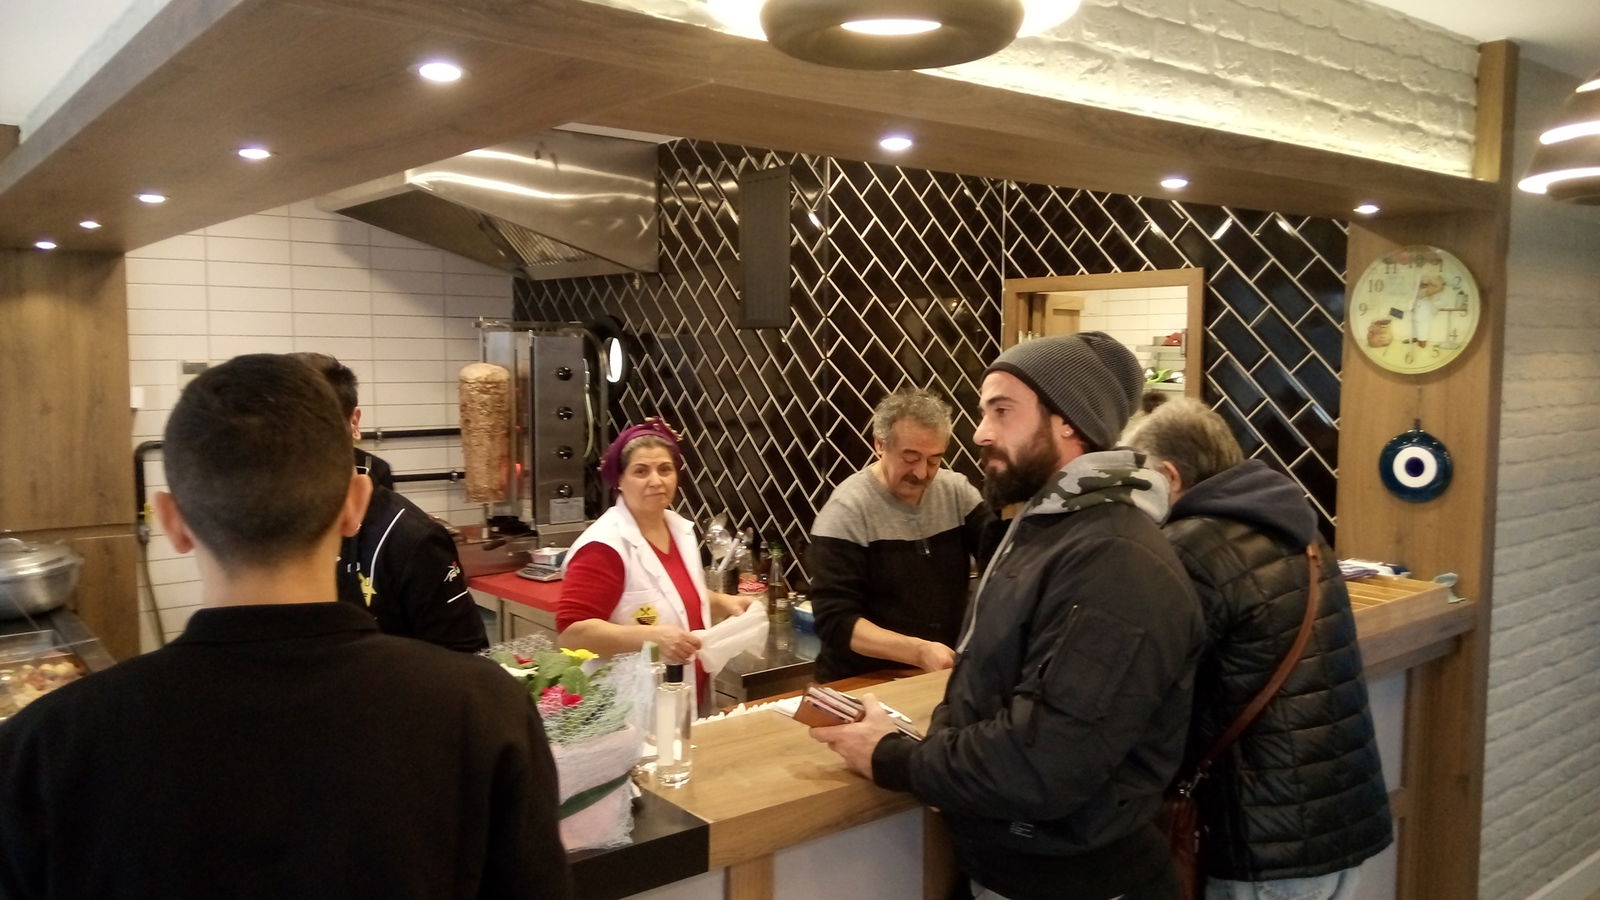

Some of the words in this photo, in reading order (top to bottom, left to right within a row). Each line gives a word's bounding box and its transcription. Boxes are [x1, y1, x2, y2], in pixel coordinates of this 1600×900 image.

[1368, 279, 1384, 293] 10
[1452, 275, 1462, 289] 2
[1358, 303, 1368, 316] 9
[1449, 328, 1459, 341] 4
[1404, 351, 1414, 364] 6
[1431, 345, 1440, 358] 5
